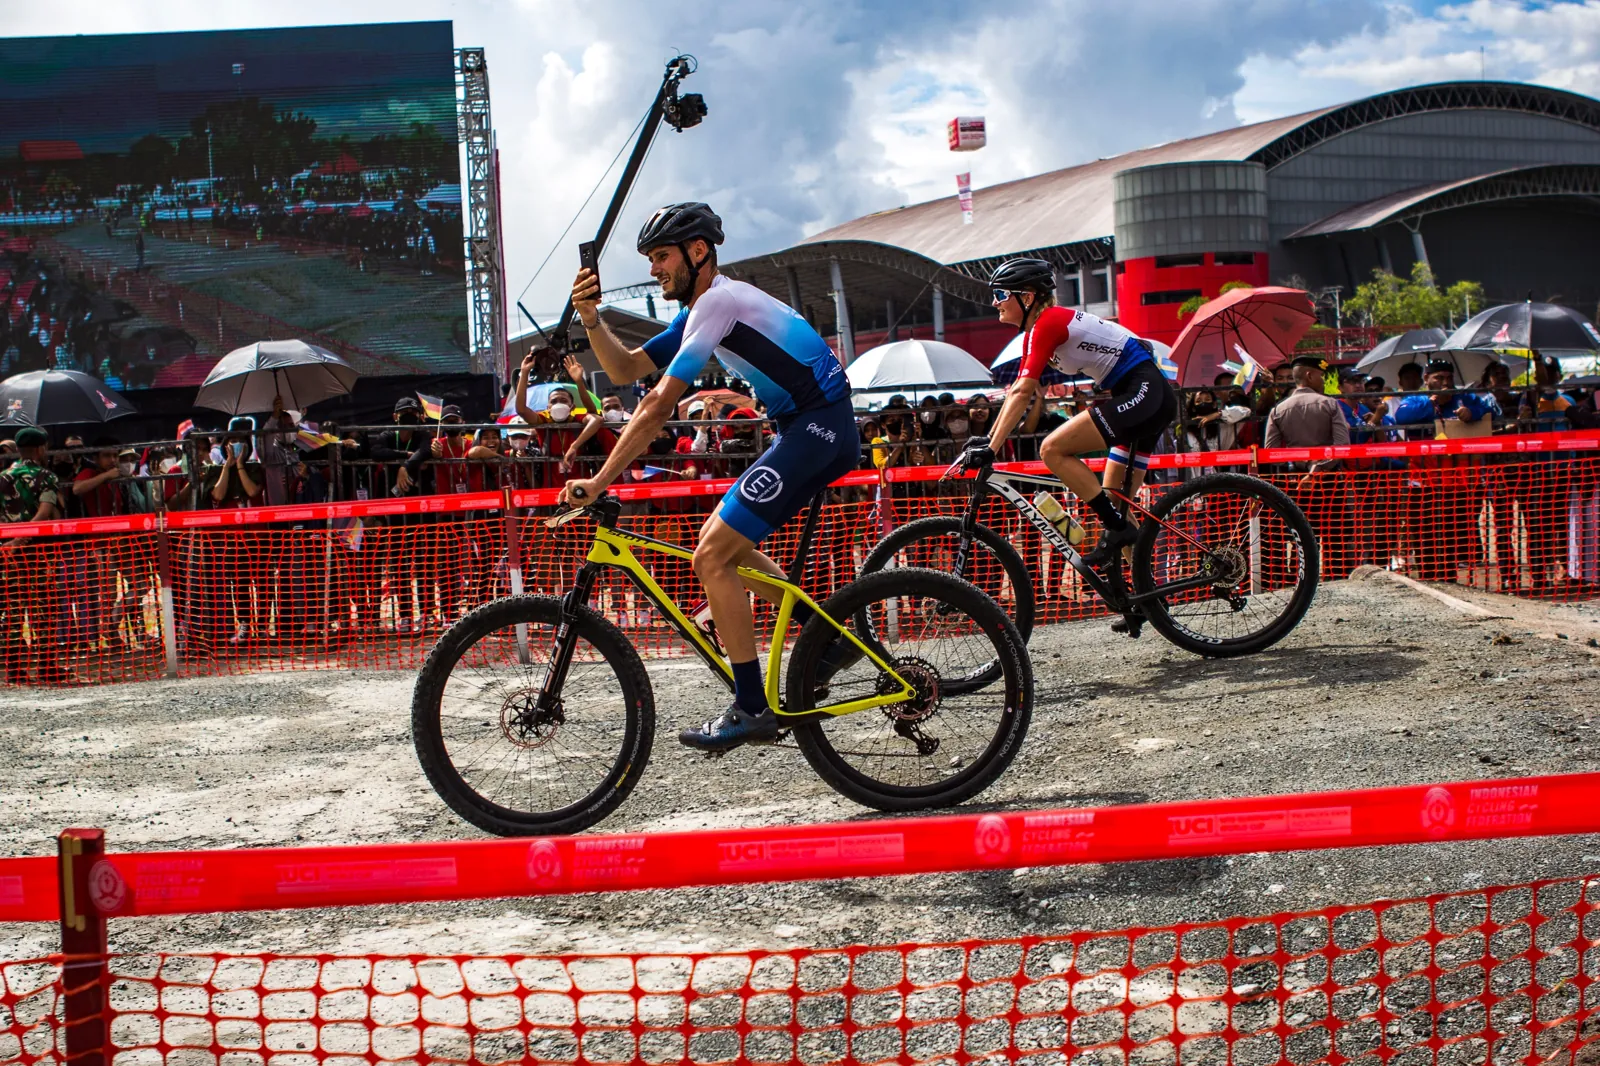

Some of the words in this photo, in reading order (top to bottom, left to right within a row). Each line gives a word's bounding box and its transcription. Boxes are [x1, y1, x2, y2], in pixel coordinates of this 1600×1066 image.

[1117, 381, 1149, 413] OLYMPIA
[746, 472, 772, 494] VTT
[606, 529, 653, 545] SCOTT
[1013, 498, 1074, 561] OLYMPIA
[1002, 630, 1025, 689] HUTCHINSON
[630, 707, 643, 762] HUTCHINSON
[999, 709, 1023, 758] SKELETON
[1470, 785, 1538, 800] INDONESIAN
[1467, 801, 1515, 814] CYCLING
[1024, 813, 1095, 828] INDONESIAN
[1175, 817, 1213, 835] UCI
[1466, 814, 1532, 827] FEDERATION
[575, 838, 646, 852] INDONESIAN
[725, 843, 764, 861] UCI
[283, 866, 320, 882] UCI
